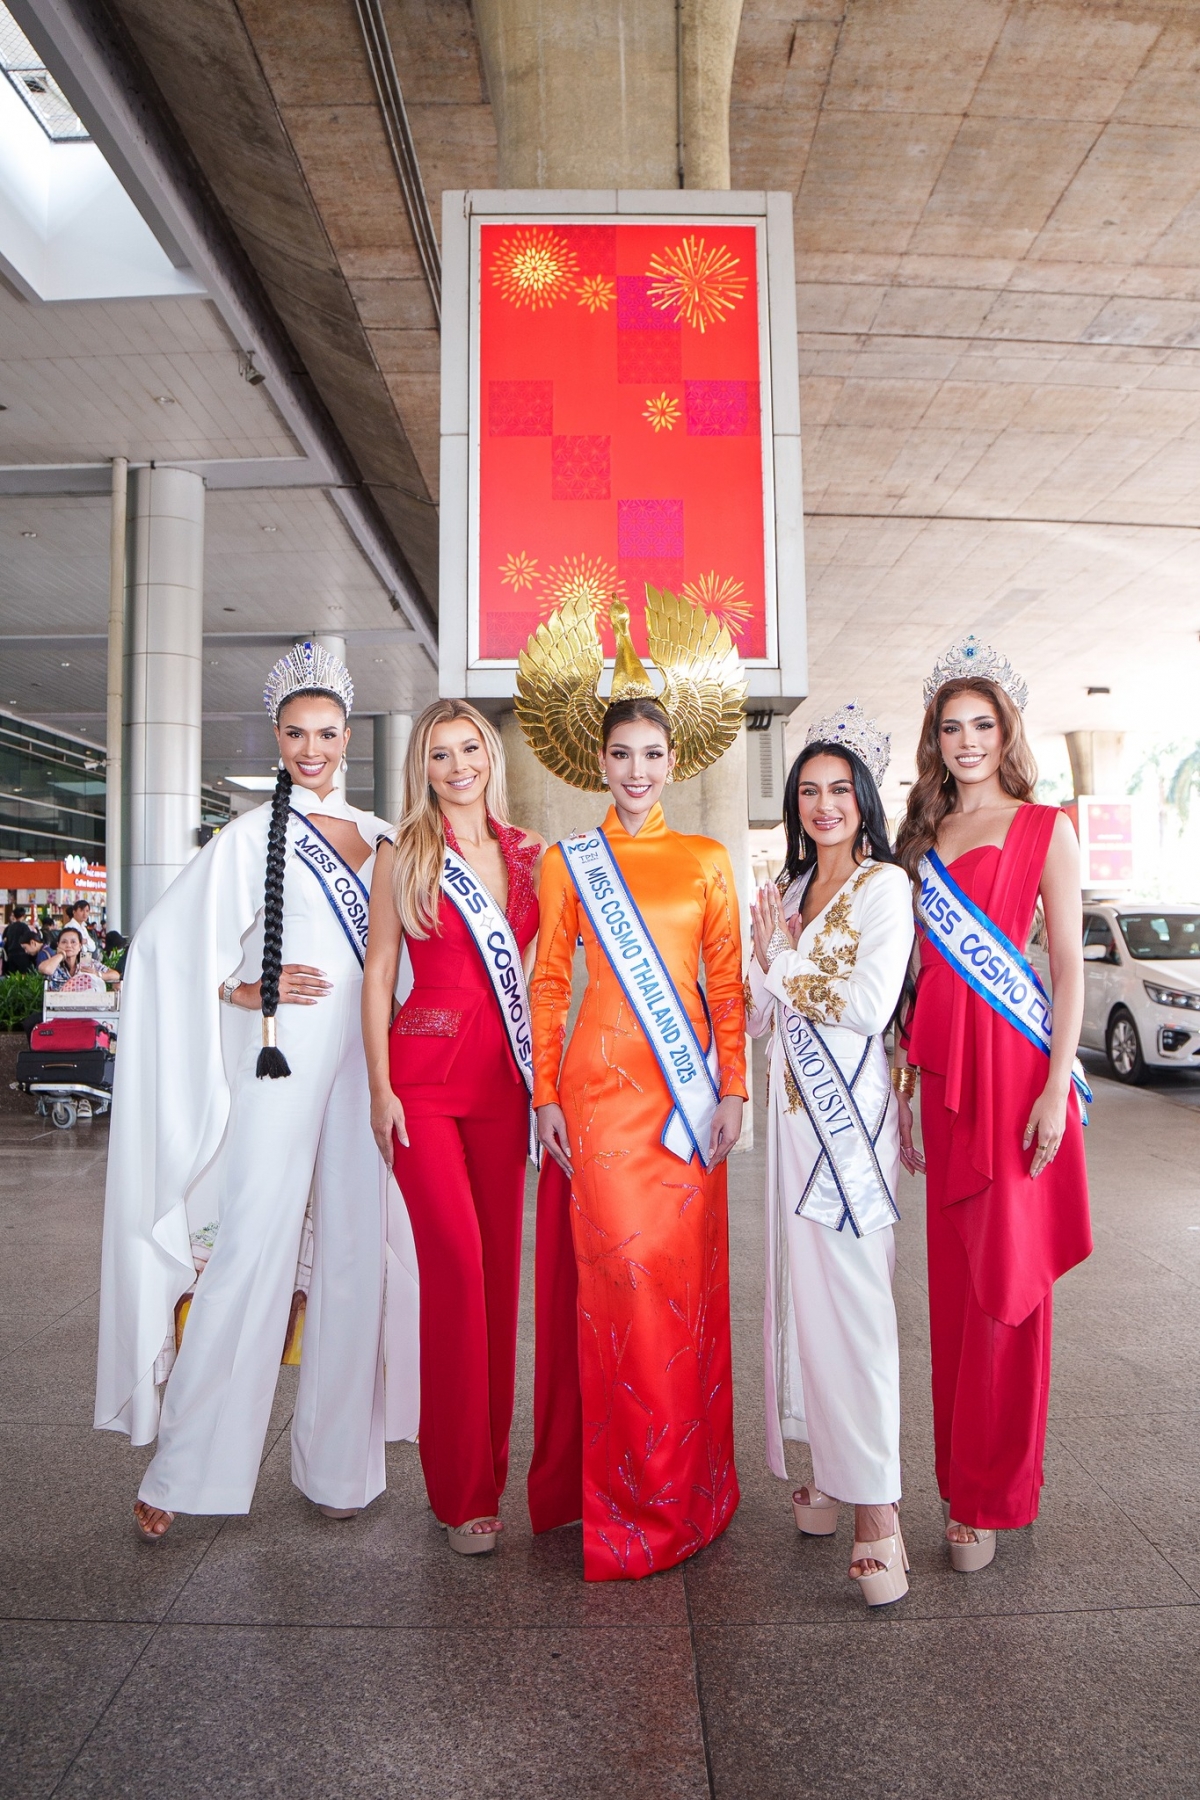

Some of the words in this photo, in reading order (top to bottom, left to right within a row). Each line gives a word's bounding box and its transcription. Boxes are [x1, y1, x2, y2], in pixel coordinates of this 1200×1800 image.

[295, 834, 337, 874] MISS
[444, 858, 488, 914] MISS
[487, 931, 523, 1023] COSMO
[585, 866, 614, 901] MISS
[600, 900, 643, 959] COSMO
[629, 957, 681, 1045] THAILAND
[669, 1044, 697, 1084] 2025
[921, 877, 962, 935] MISS
[959, 933, 1027, 1004] COSMO
[812, 1077, 854, 1137] USVI
